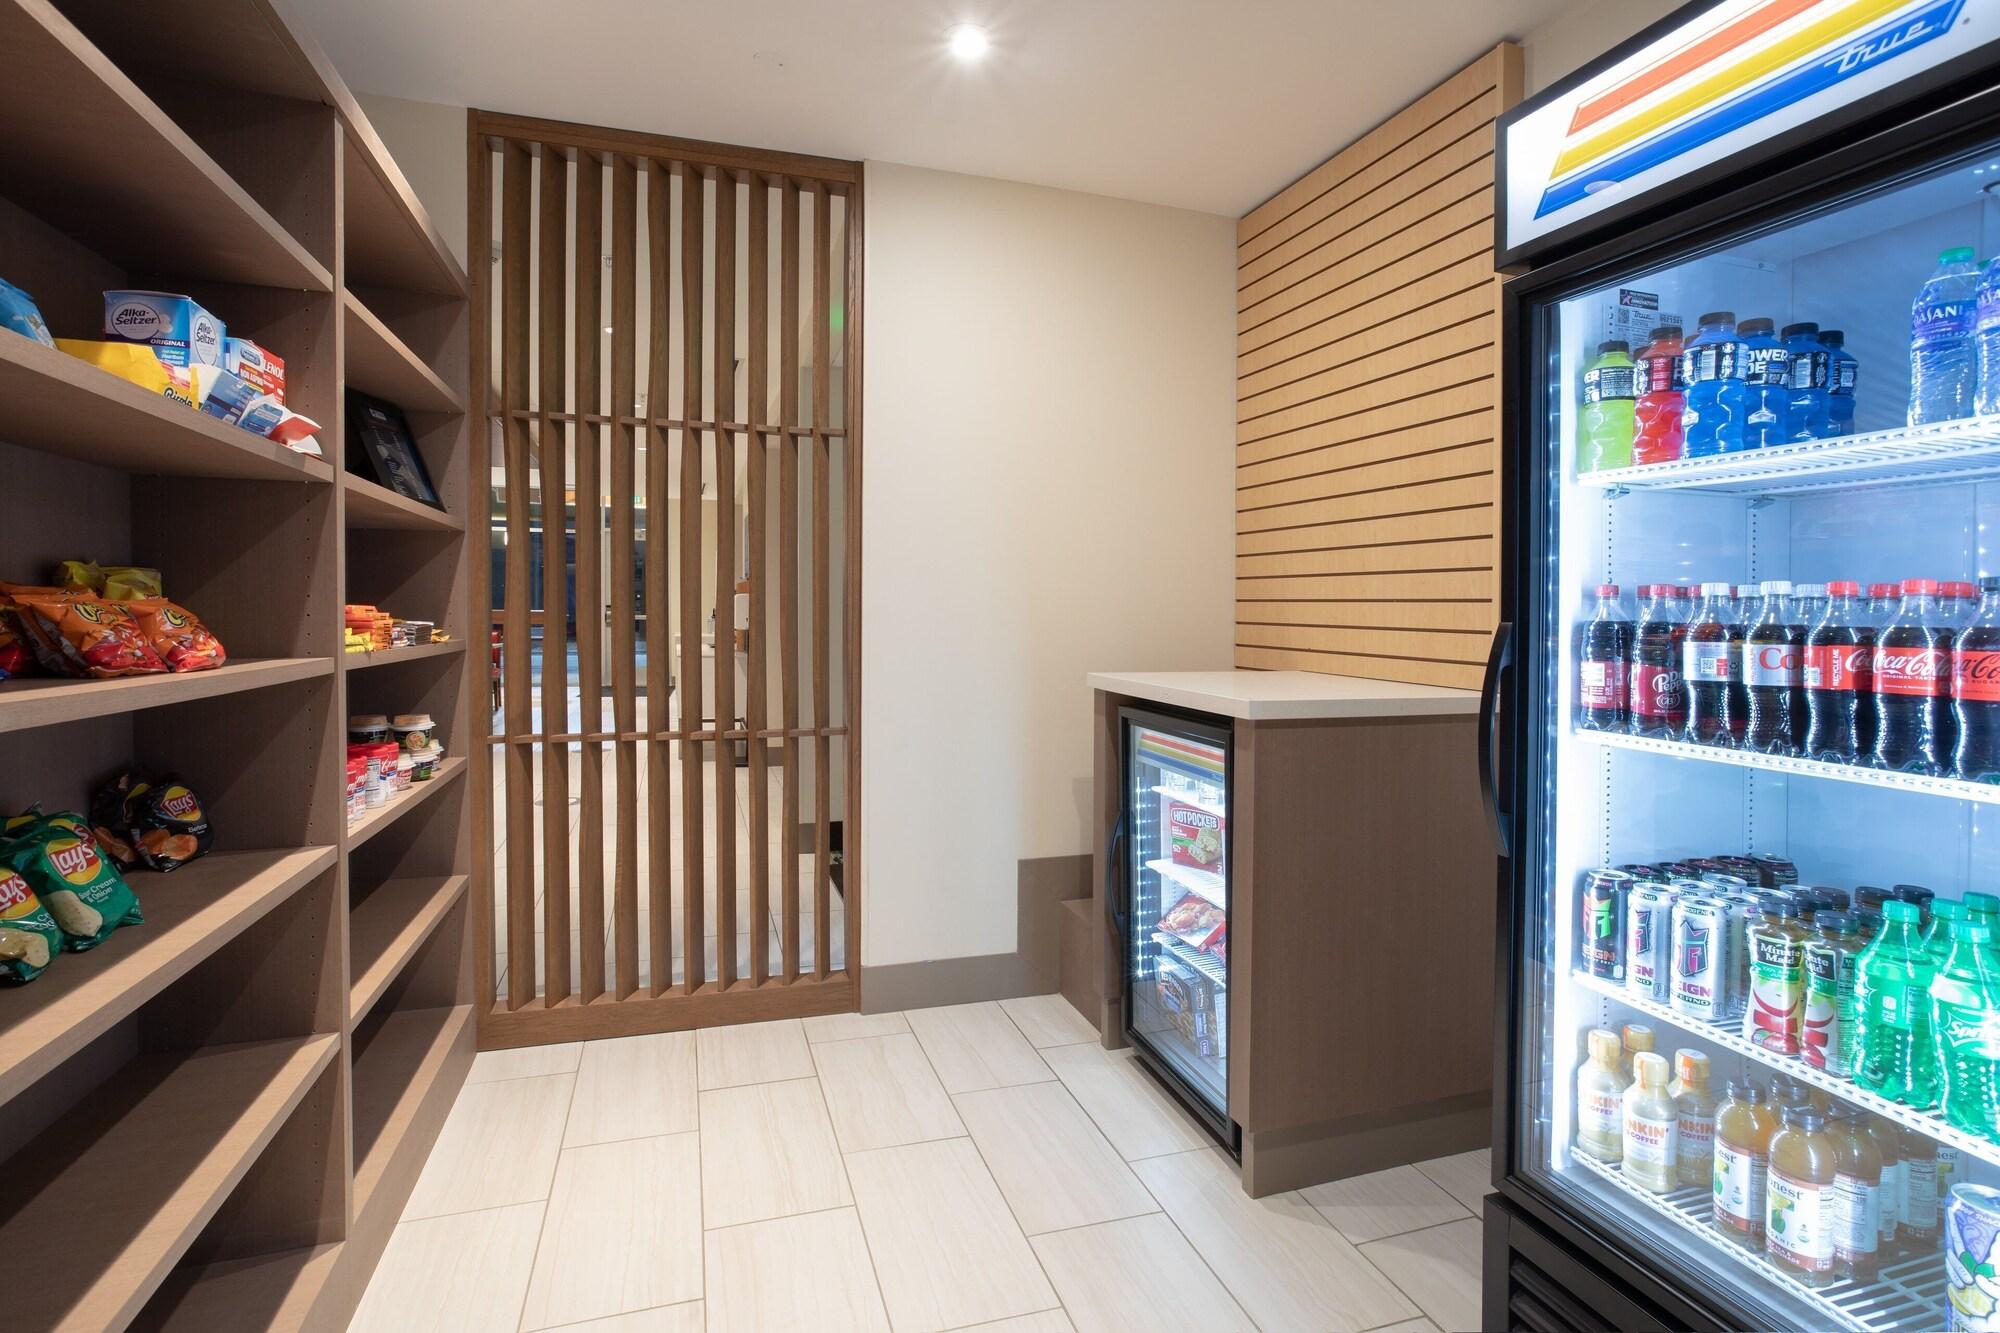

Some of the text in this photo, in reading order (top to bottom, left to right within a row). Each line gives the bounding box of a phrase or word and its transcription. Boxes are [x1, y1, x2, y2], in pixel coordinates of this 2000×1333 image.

[119, 308, 150, 317] Alka-
[114, 316, 157, 326] Seltzer
[150, 338, 187, 347] ORIGINAL
[50, 842, 96, 877] Lay's
[1765, 953, 1796, 964] Maid
